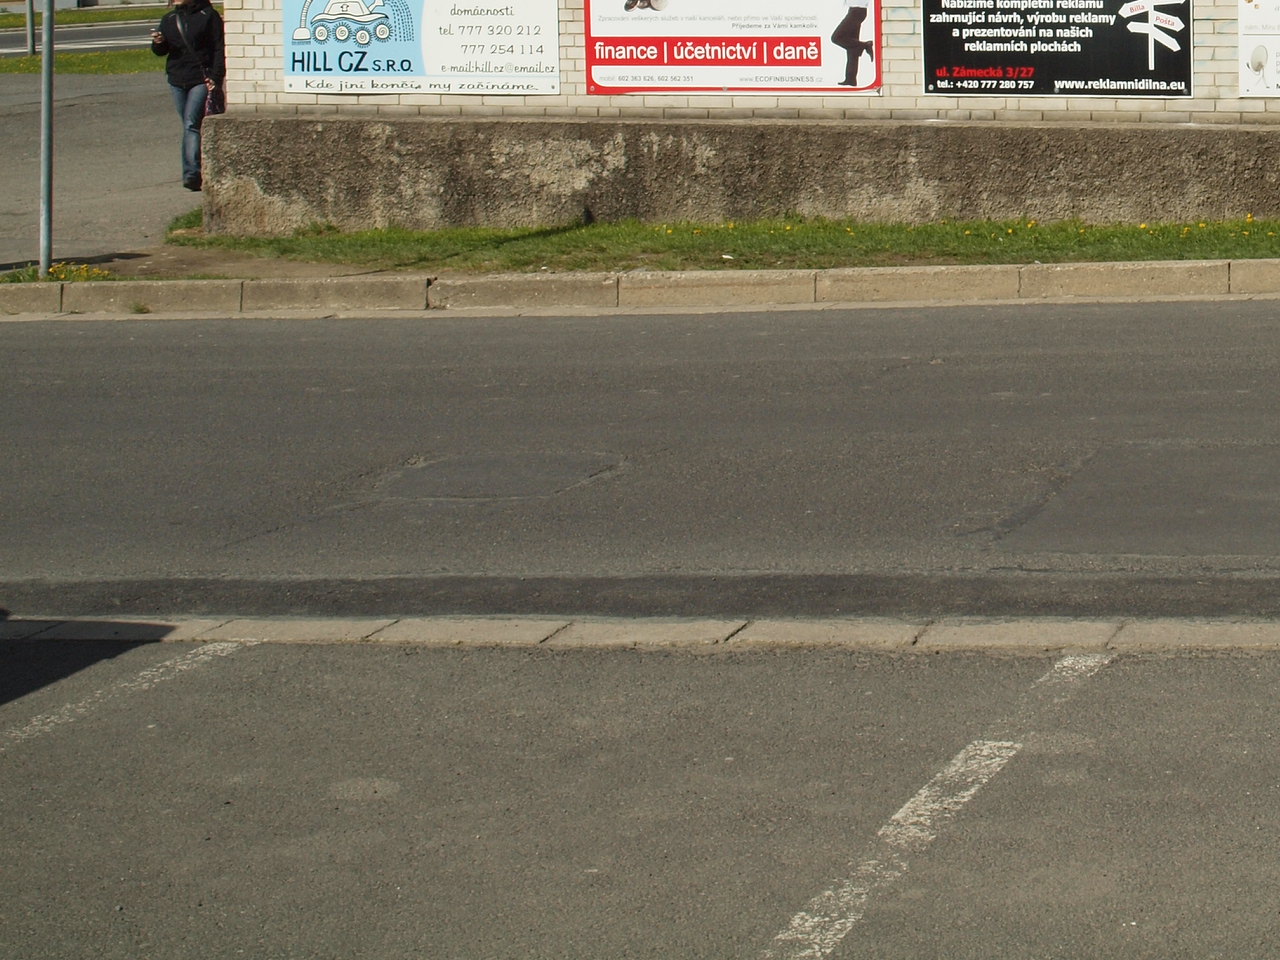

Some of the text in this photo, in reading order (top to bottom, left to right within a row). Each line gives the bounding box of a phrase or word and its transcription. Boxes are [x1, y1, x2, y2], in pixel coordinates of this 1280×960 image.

[450, 4, 515, 16] domácnosti
[1130, 5, 1145, 13] Billa
[930, 12, 1116, 25] zahrnující návrh, výrobu reklamy
[459, 25, 482, 35] 777
[488, 25, 512, 35] 320
[517, 25, 541, 35] 212
[952, 27, 1093, 40] a prezentování na našich
[461, 45, 544, 54] 777 254 114
[594, 42, 818, 60] finance účetnictví daně
[964, 41, 1081, 54] reklamních plochách
[292, 51, 413, 72] HILL CZ S.R.O.
[936, 67, 1034, 78] ul. Zámecká 3/27
[305, 80, 334, 89] Kde
[339, 81, 366, 91] jiní
[429, 82, 451, 92] my
[937, 80, 1034, 89] tel.: +420 777 280 757
[1054, 79, 1184, 90] www.reklamnidilna.eu
